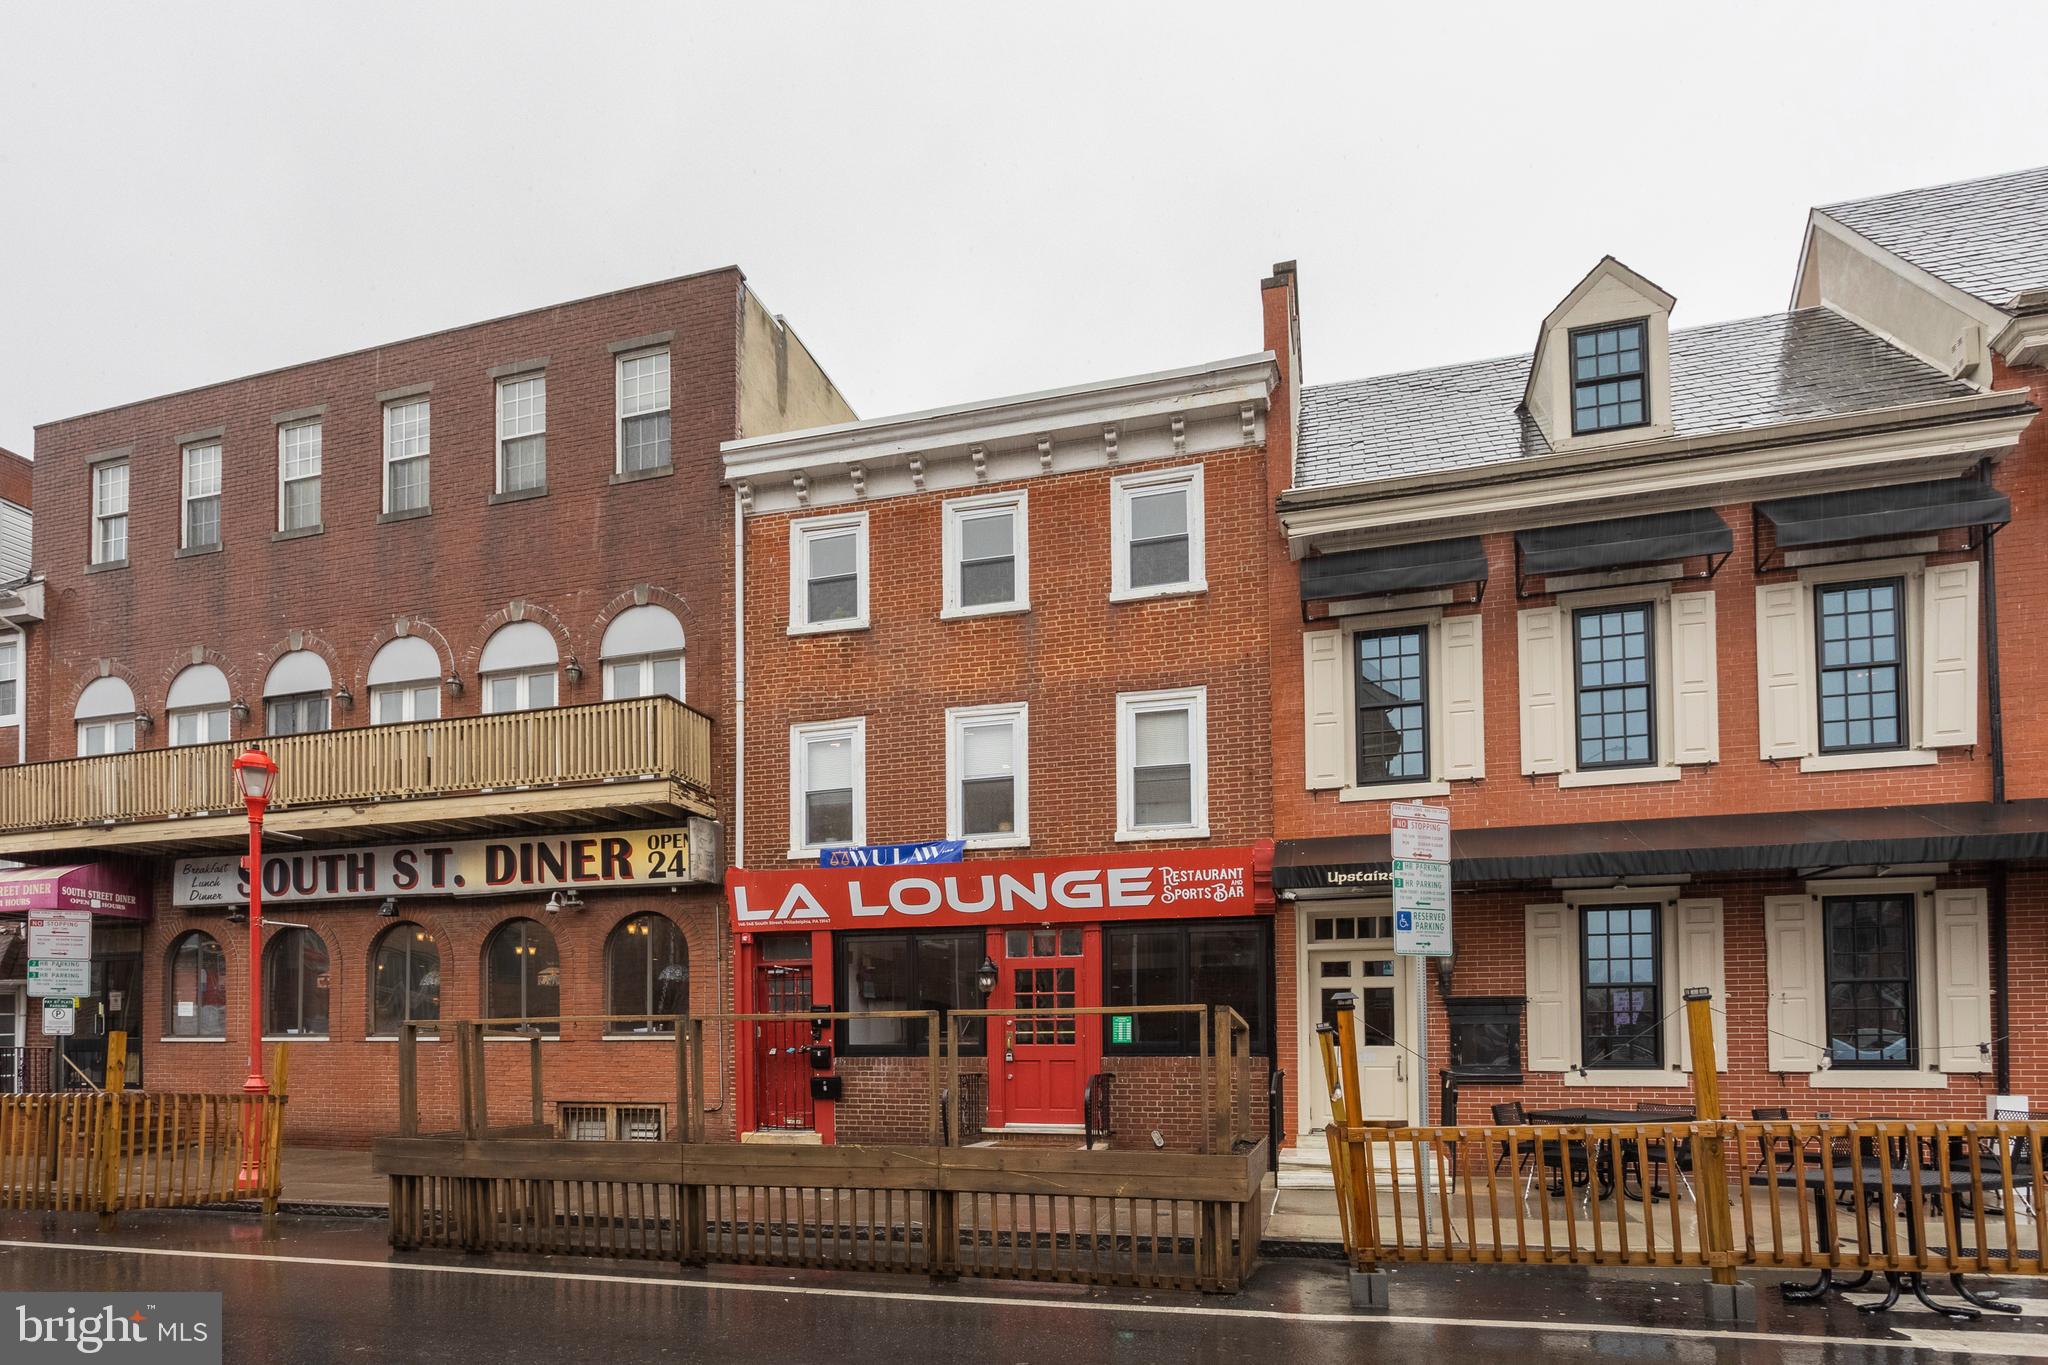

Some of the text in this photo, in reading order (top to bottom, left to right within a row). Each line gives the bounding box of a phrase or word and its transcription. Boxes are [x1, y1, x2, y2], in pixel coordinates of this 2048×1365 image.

[1396, 820, 1441, 831] NO STOPPING
[850, 846, 944, 866] WU LAW
[183, 862, 230, 875] Breakfast
[393, 847, 466, 891] ST.
[485, 837, 634, 886] DINER
[648, 850, 686, 879] 24
[1396, 861, 1401, 869] 2
[1416, 863, 1442, 872] PARKING
[192, 876, 221, 888] Lunch
[1416, 880, 1442, 889] PARKING
[23, 883, 51, 896] DINER
[61, 886, 136, 904] SOUTH STREET DINER
[189, 890, 223, 901] Dinner
[734, 867, 1155, 921] LA LOUNGE
[5, 898, 31, 907] HOURS
[70, 898, 126, 910] OPEN HOURS
[1413, 912, 1446, 921] RESERVED
[1416, 922, 1445, 931] PARKING
